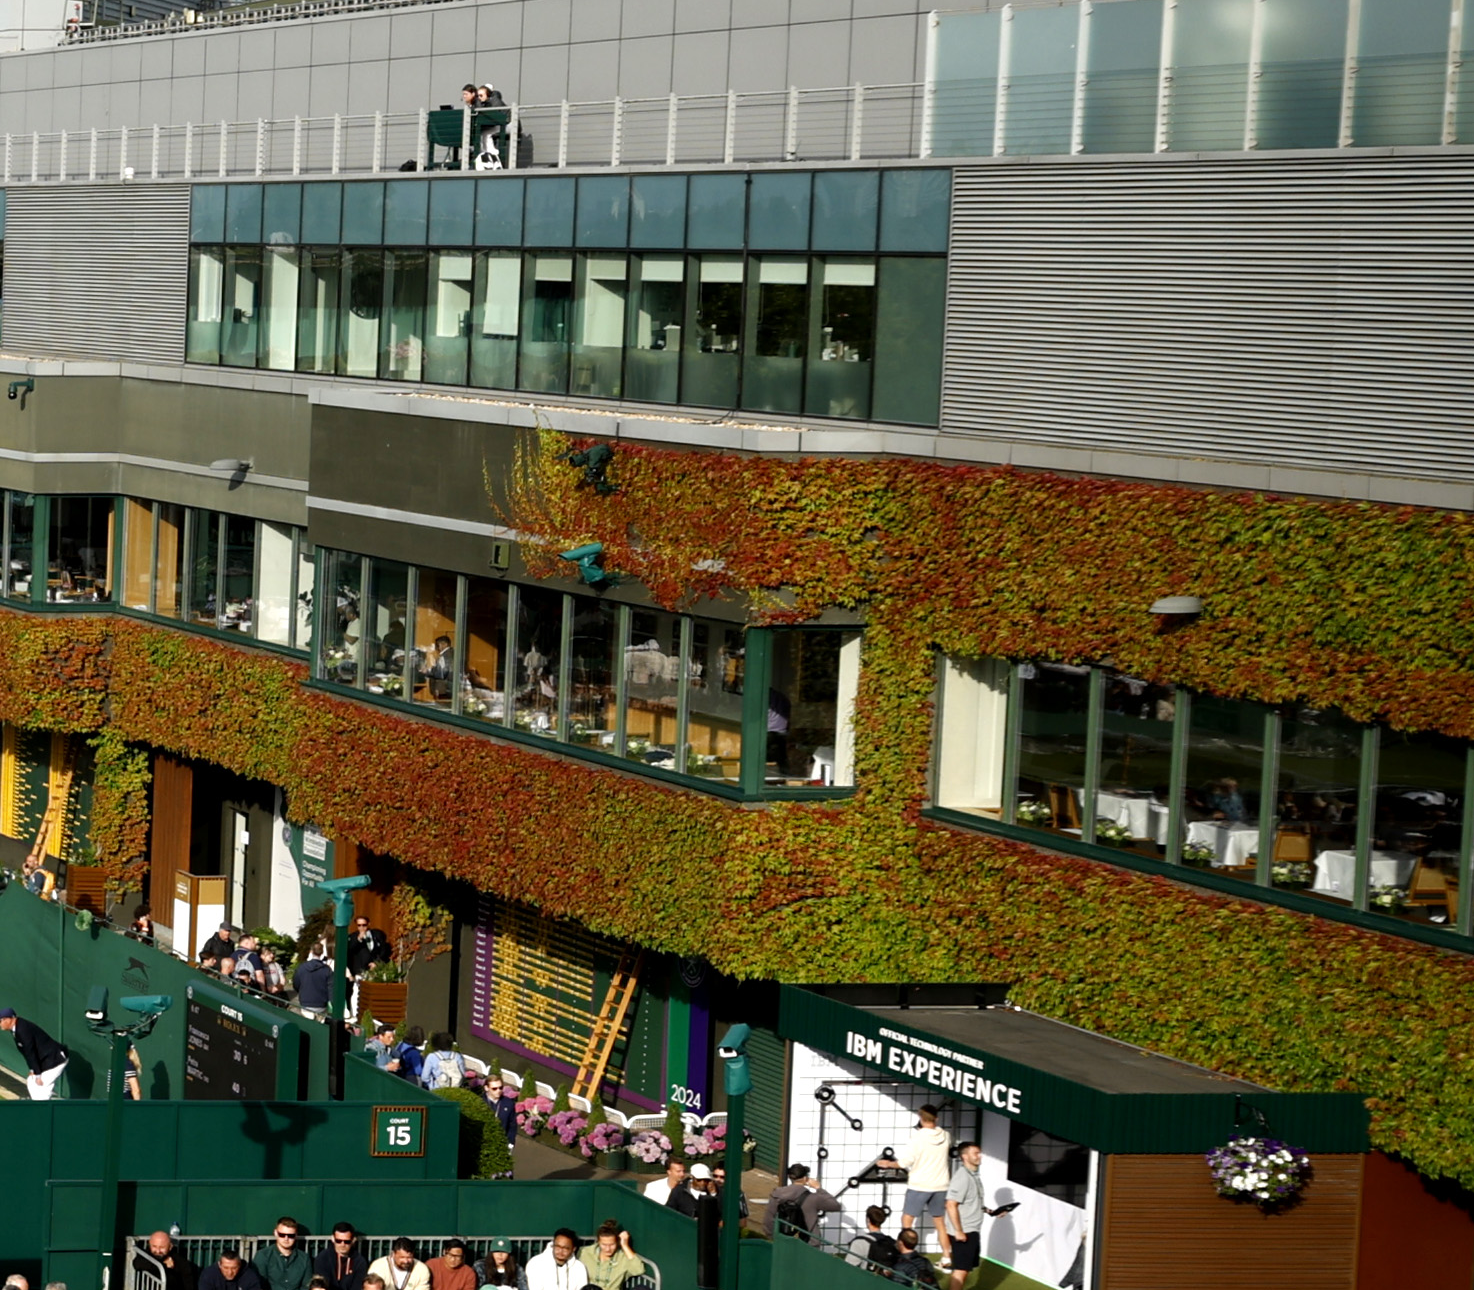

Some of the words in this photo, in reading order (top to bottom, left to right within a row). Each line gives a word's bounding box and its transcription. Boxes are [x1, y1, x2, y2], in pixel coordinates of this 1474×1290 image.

[221, 1004, 237, 1018] COURT
[879, 1027, 909, 1045] OFFICIAL
[909, 1036, 953, 1059] TECHNOLOGY
[952, 1052, 984, 1070] PARTNER
[846, 1031, 882, 1065] IBM
[888, 1046, 1022, 1114] EXPERIENCE
[671, 1084, 702, 1110] 2024
[386, 1126, 411, 1146] 15
